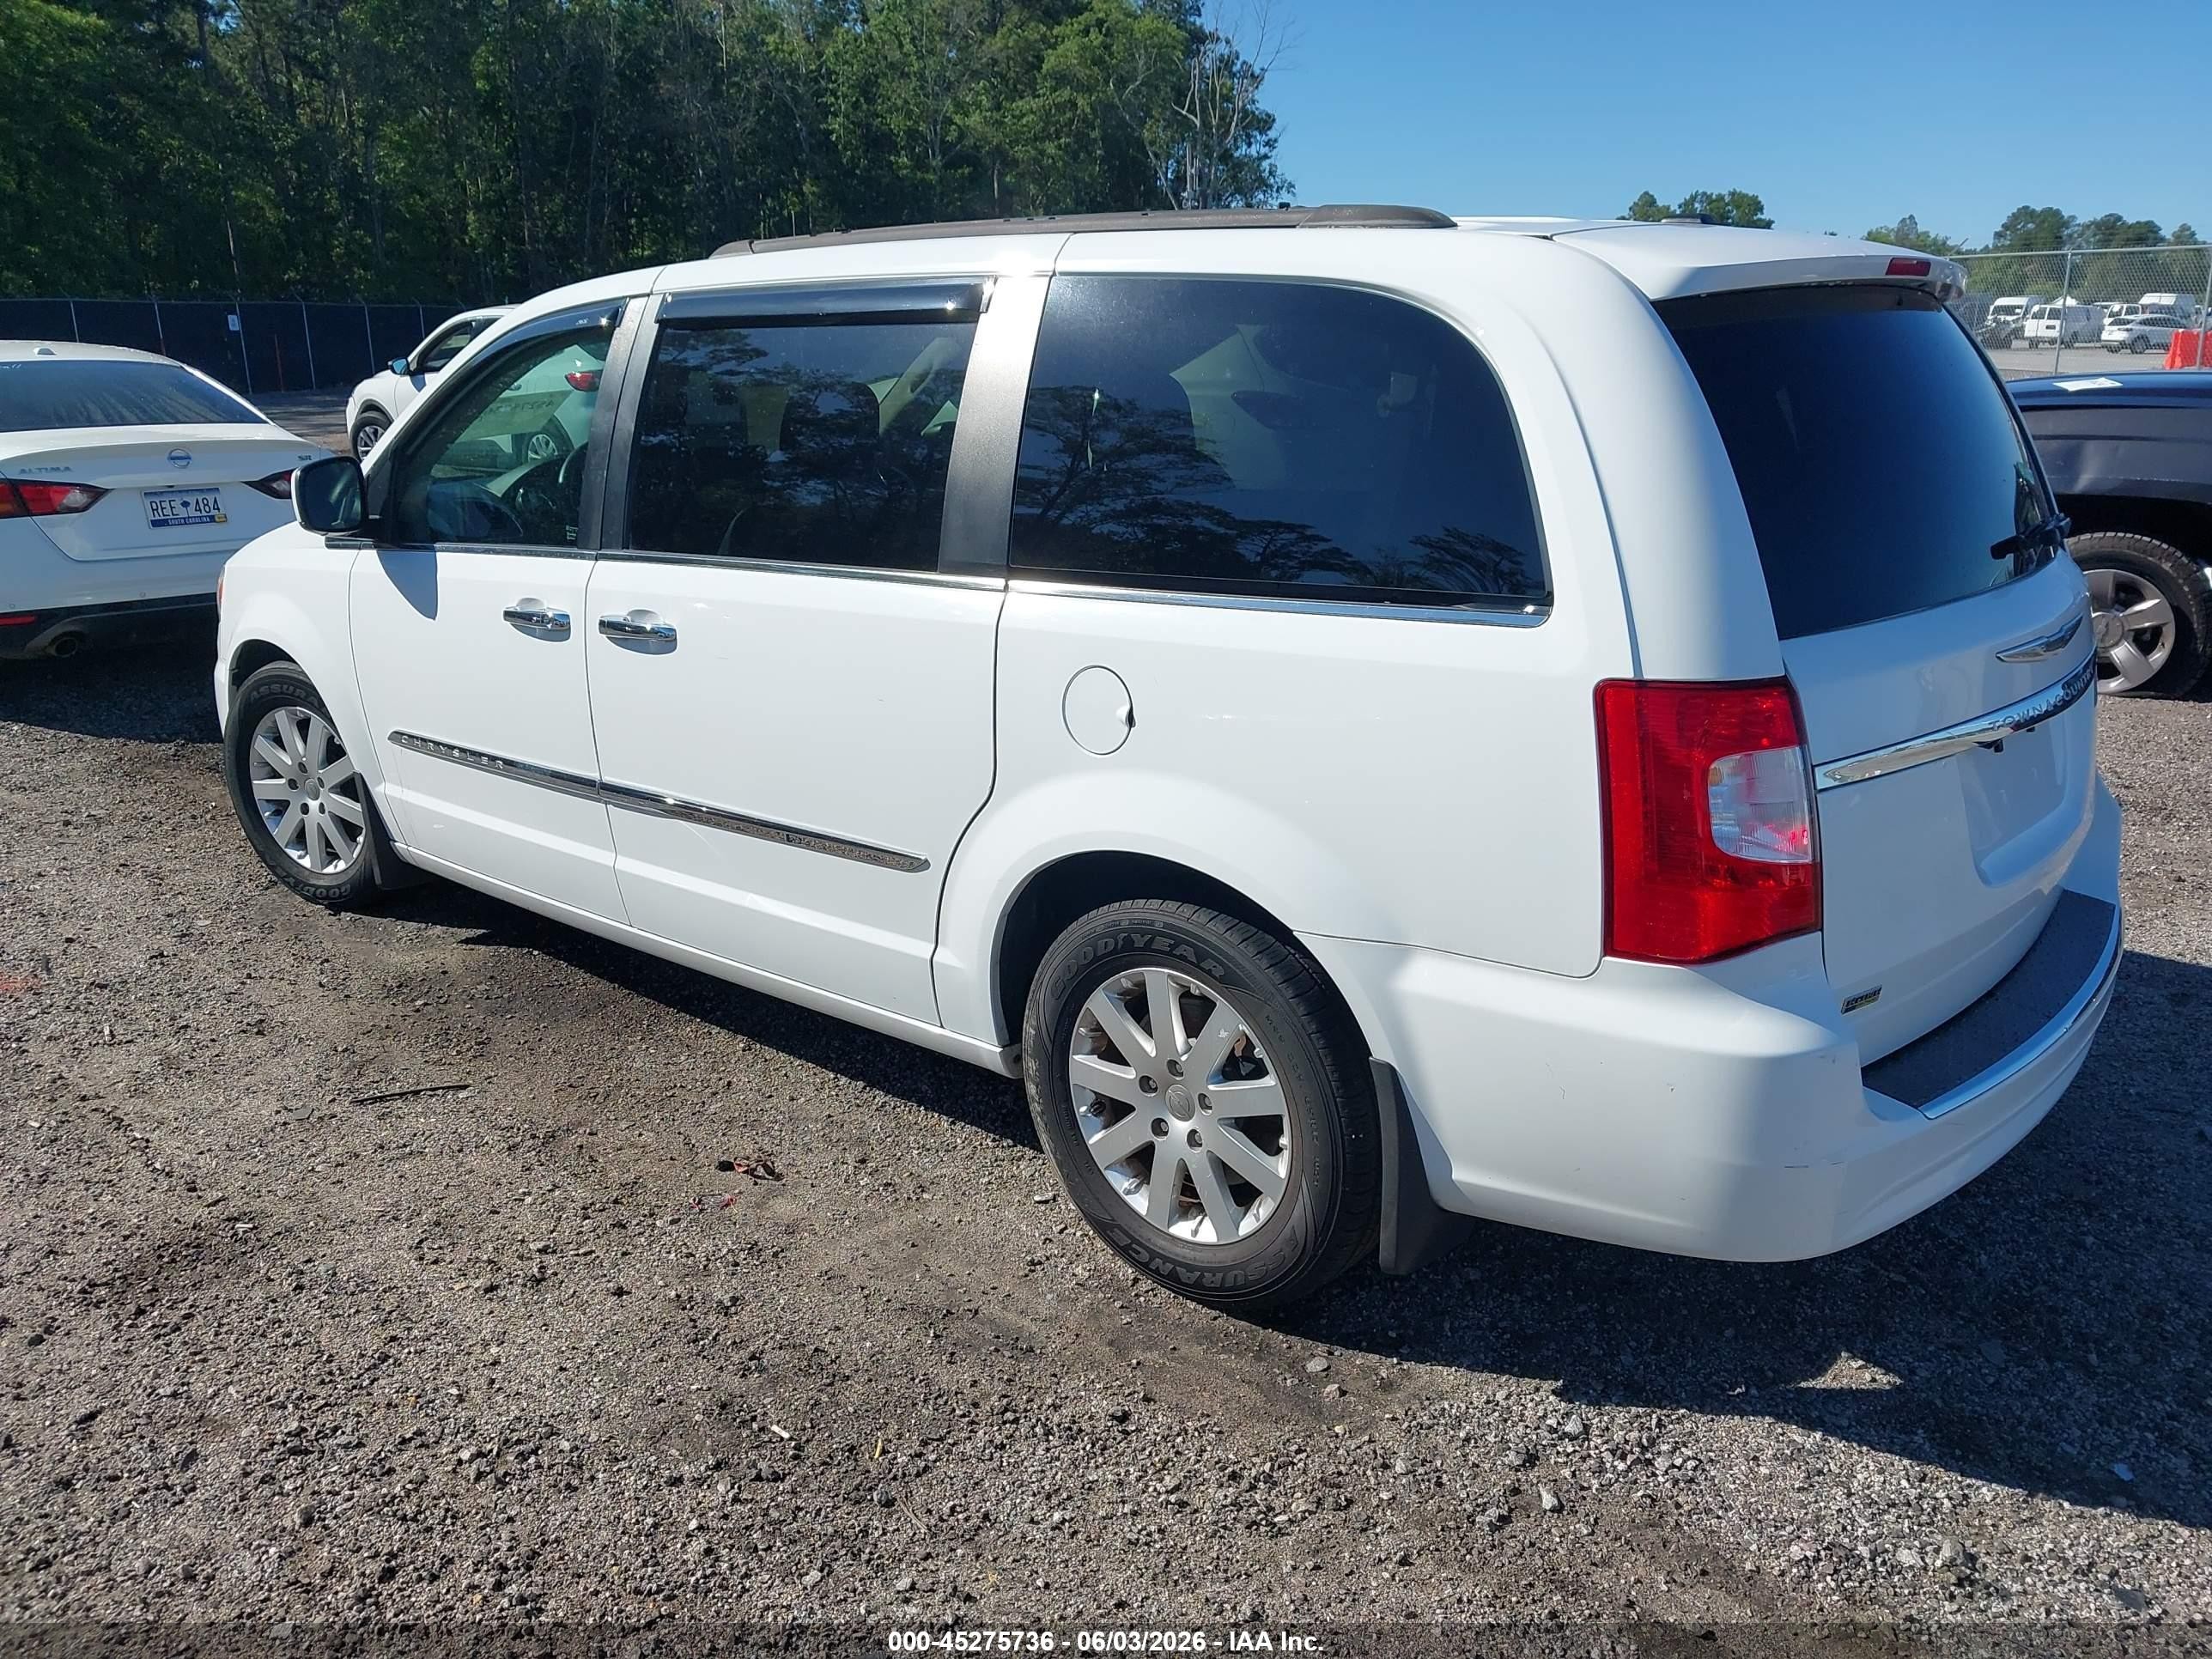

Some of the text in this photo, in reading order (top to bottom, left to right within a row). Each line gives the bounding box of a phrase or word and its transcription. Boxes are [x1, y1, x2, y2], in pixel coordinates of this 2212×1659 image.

[149, 495, 221, 518] REE 484
[401, 735, 504, 769] CHRYSLER
[1050, 933, 1225, 1001] GOODYEAR
[1106, 1224, 1300, 1288] ASSURANCE
